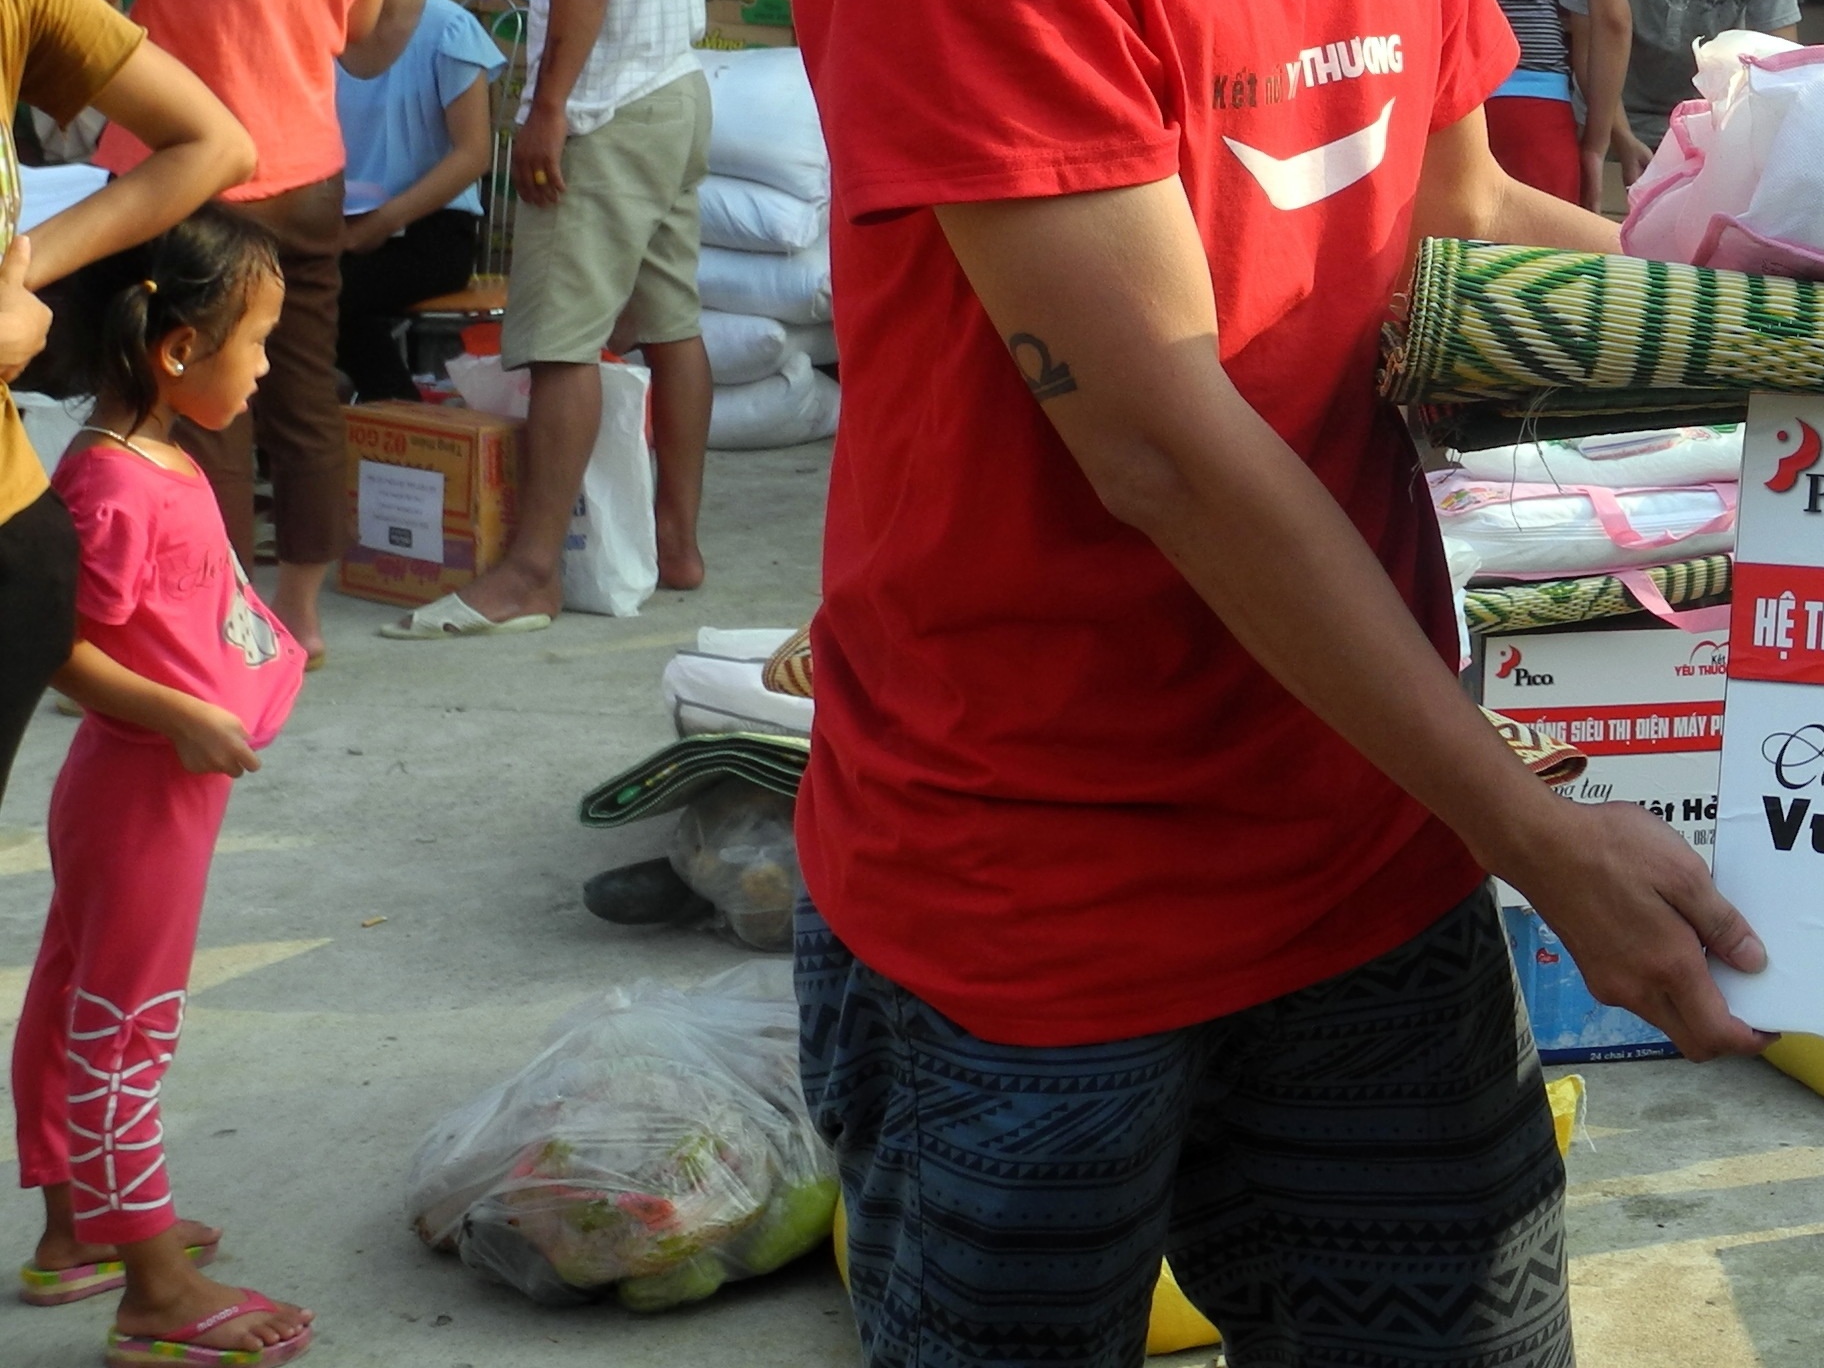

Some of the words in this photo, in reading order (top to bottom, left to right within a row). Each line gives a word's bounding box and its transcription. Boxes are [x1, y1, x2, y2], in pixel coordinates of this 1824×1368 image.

[1754, 589, 1797, 660] HỆ
[1674, 663, 1695, 677] YÊU
[1570, 717, 1604, 743] SIÊU
[1607, 719, 1632, 746] THỊ
[1635, 714, 1670, 745] ĐIỆN
[1674, 713, 1709, 738] MÁY
[1603, 1050, 1625, 1061] chai
